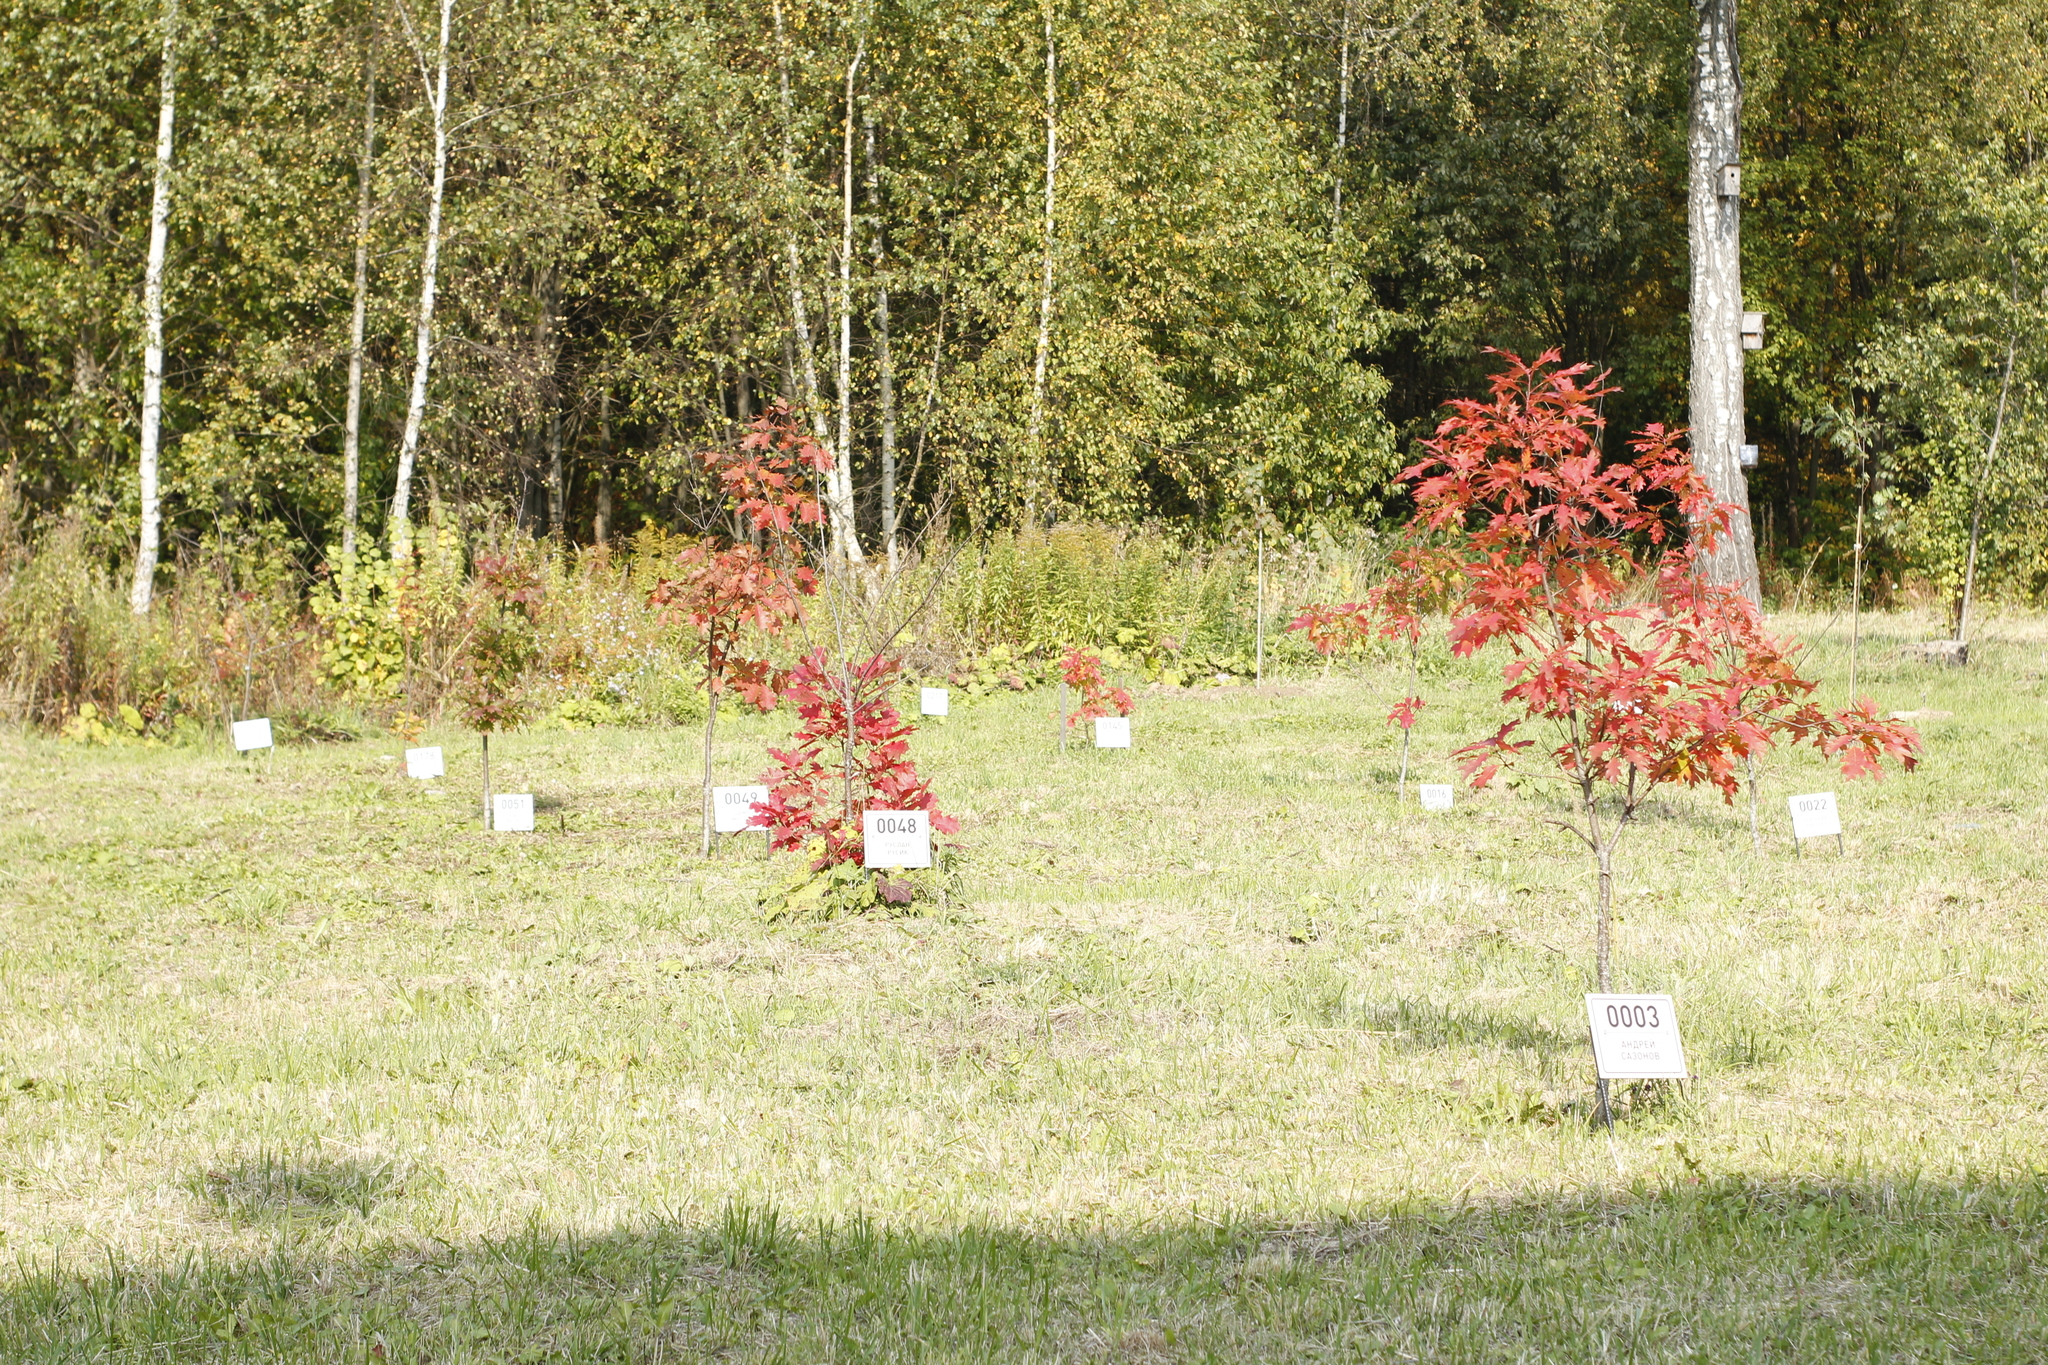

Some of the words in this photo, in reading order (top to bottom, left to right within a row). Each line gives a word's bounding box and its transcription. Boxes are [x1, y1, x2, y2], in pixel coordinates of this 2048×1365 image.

[724, 791, 758, 805] 0049
[1426, 788, 1447, 798] 0016
[501, 799, 524, 809] 0051
[1798, 799, 1828, 812] 0022
[876, 817, 917, 834] 0048
[1606, 1004, 1660, 1029] 0003
[1621, 1038, 1656, 1050] АНДРЕЙ
[1621, 1051, 1661, 1061] САЗОНОВ
